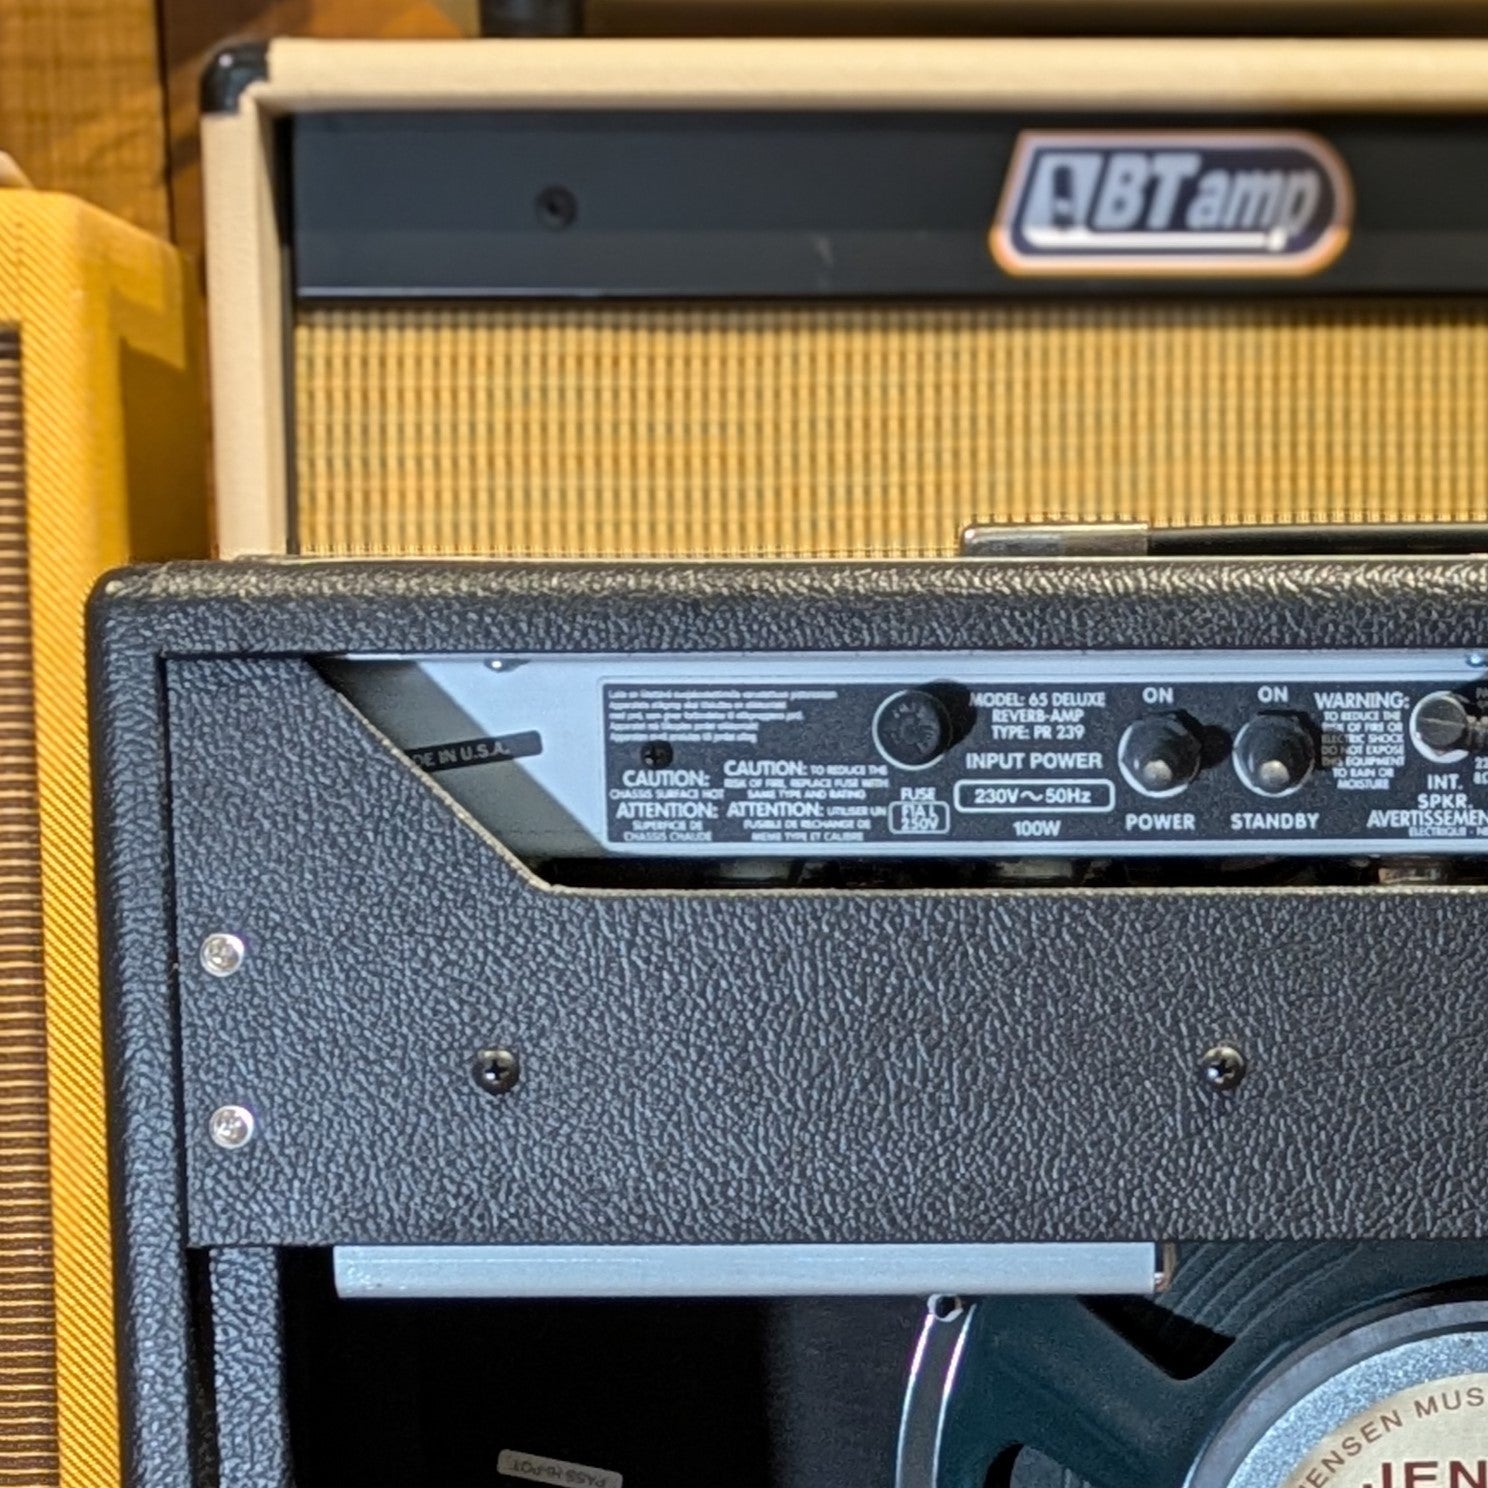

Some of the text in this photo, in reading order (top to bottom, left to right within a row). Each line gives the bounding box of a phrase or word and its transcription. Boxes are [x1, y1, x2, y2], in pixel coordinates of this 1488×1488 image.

[969, 692, 1026, 707] MODEL:
[1052, 691, 1106, 707] DELUXE
[1142, 687, 1175, 704] ON
[1257, 686, 1289, 703] ON
[1313, 691, 1410, 710] WARNING:
[1323, 711, 1339, 721] TO
[991, 725, 1086, 740] TYPE: PR 239
[1346, 721, 1361, 732] OF
[439, 749, 458, 764] IN
[965, 752, 1104, 770] INPUT POWER
[723, 760, 808, 776] CAUTION:
[1332, 767, 1348, 778] TO
[622, 769, 711, 787] CAUTION:
[1427, 773, 1463, 790] INT.
[901, 787, 936, 800] FUSE
[1417, 793, 1474, 809] SPKR.
[615, 801, 719, 819] ATTENTION:
[726, 801, 824, 817] ATTENTION:
[1012, 819, 1062, 837] 100W
[1125, 813, 1196, 831] POWER
[1230, 812, 1320, 831] STANDBY
